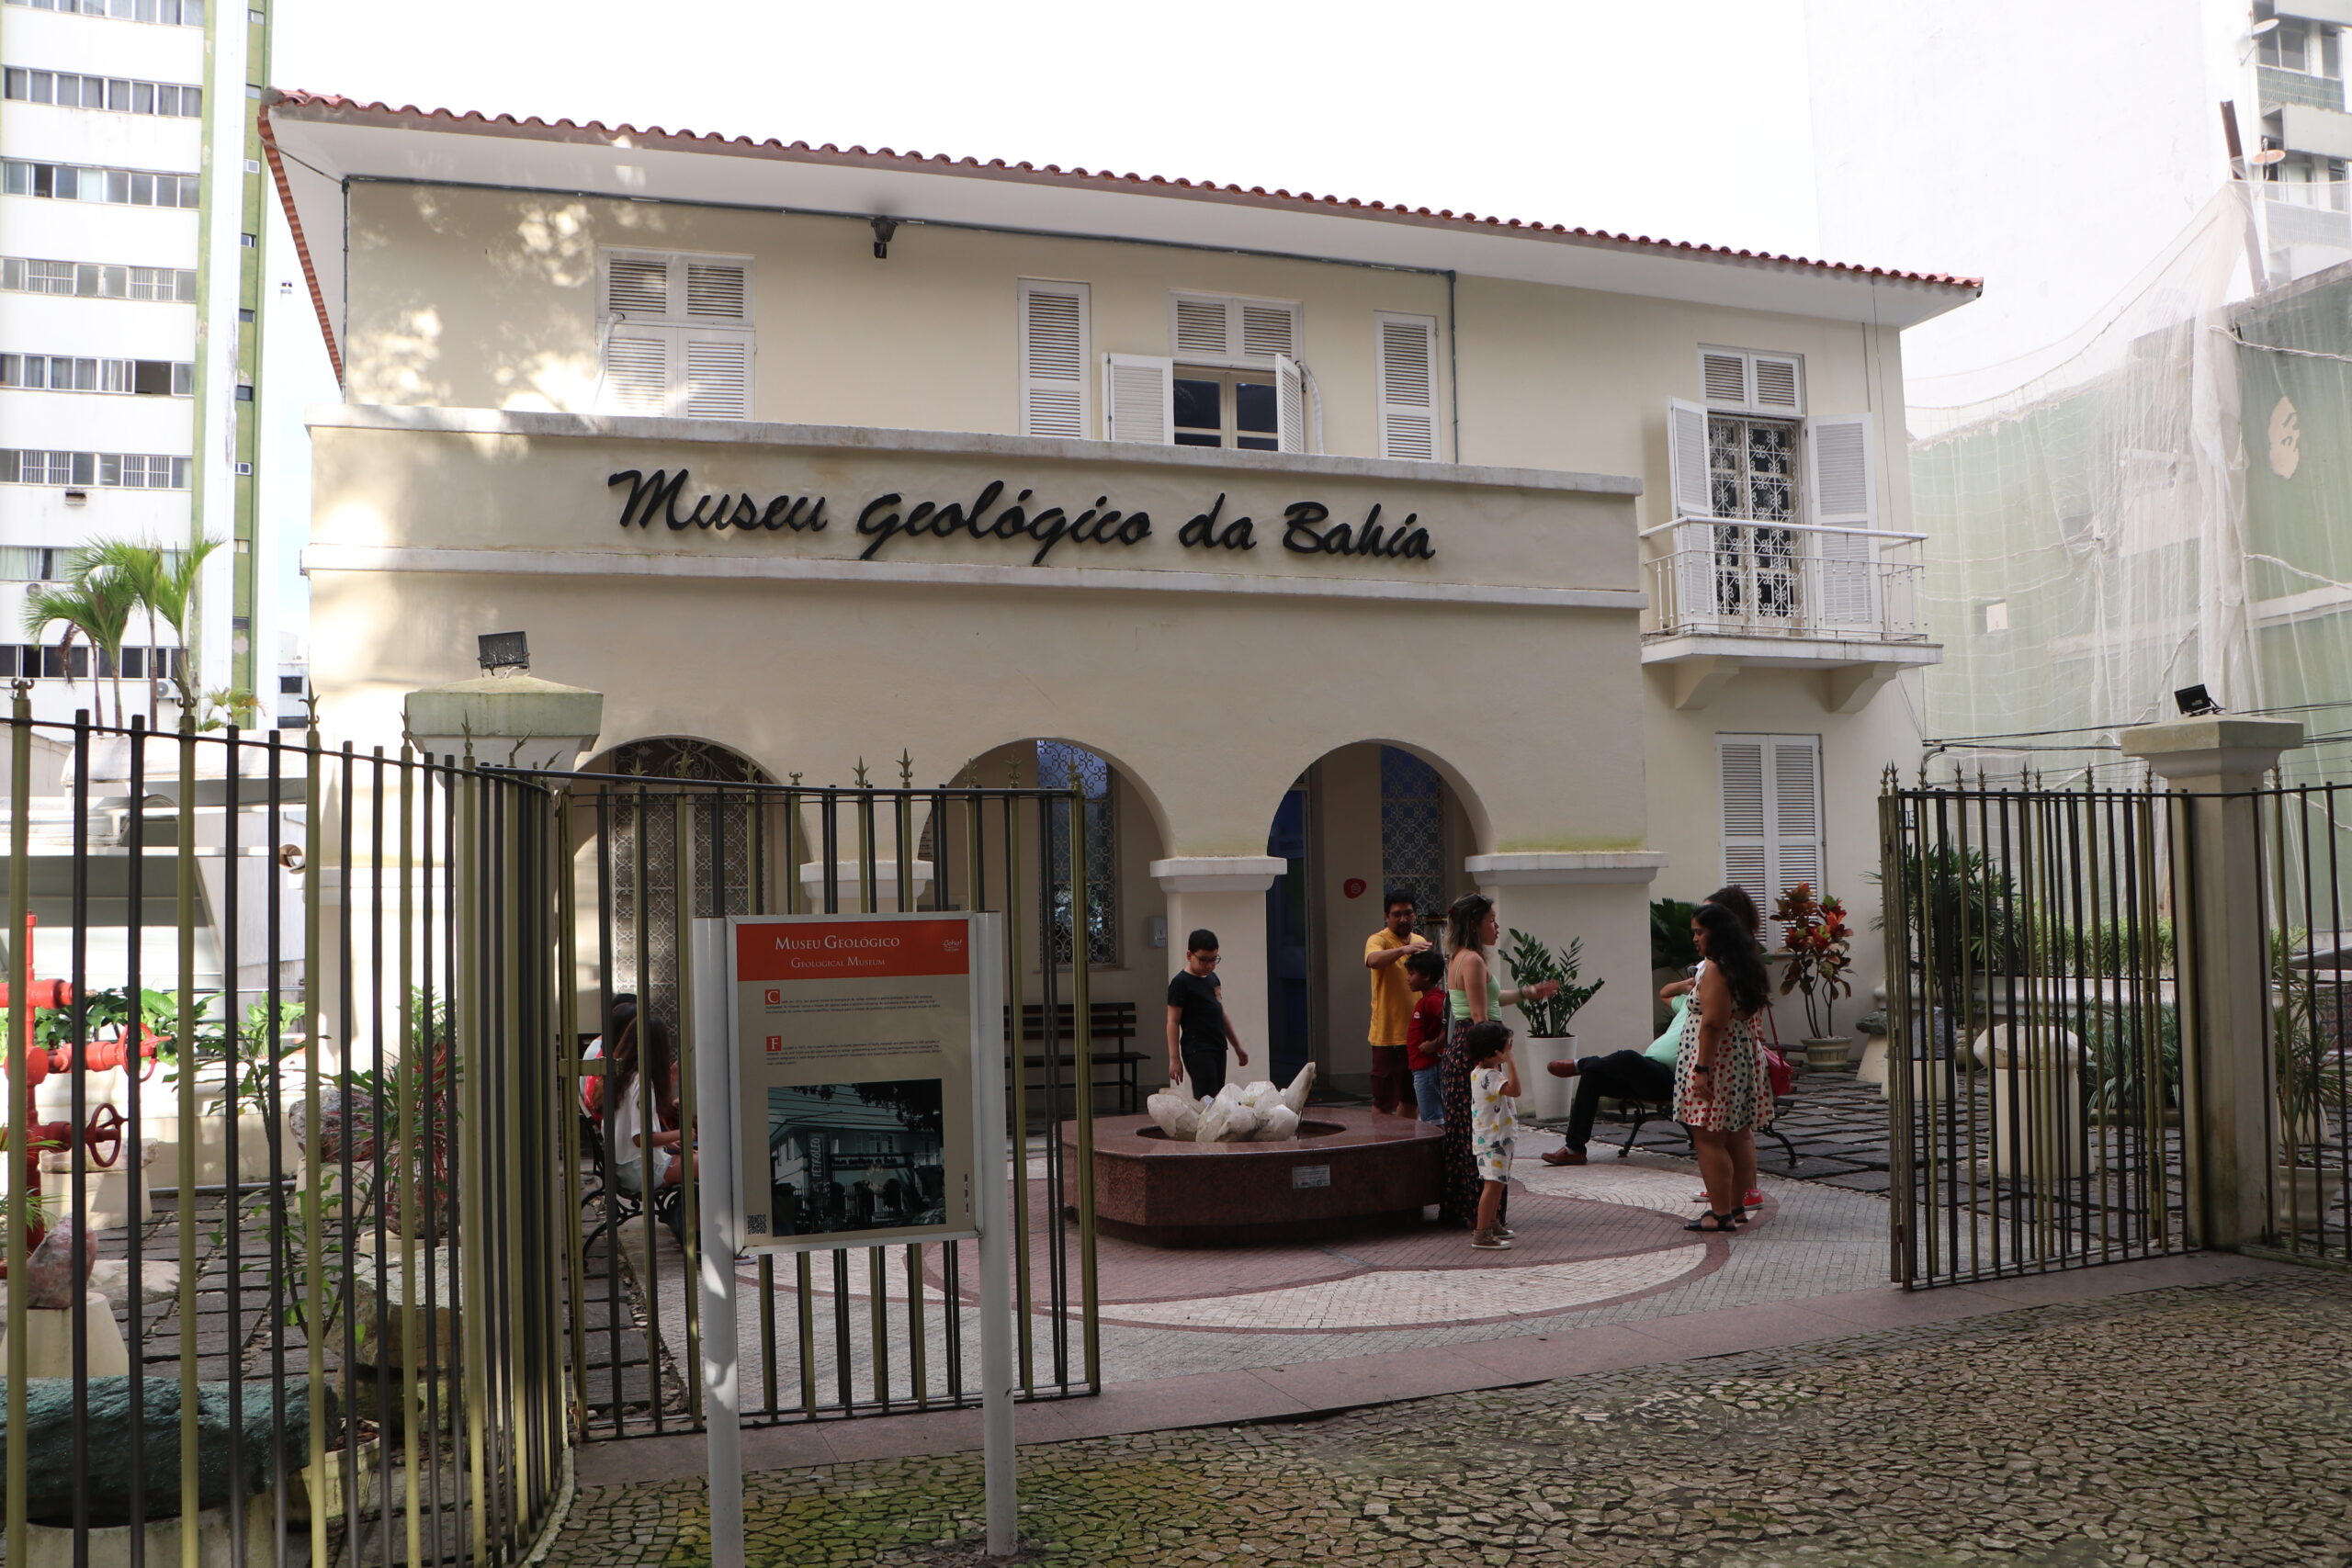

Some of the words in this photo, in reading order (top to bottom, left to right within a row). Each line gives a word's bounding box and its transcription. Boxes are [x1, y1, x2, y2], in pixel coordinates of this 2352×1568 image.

[607, 468, 829, 534] Museu
[1178, 492, 1258, 552] da
[1282, 501, 1436, 561] Bahia
